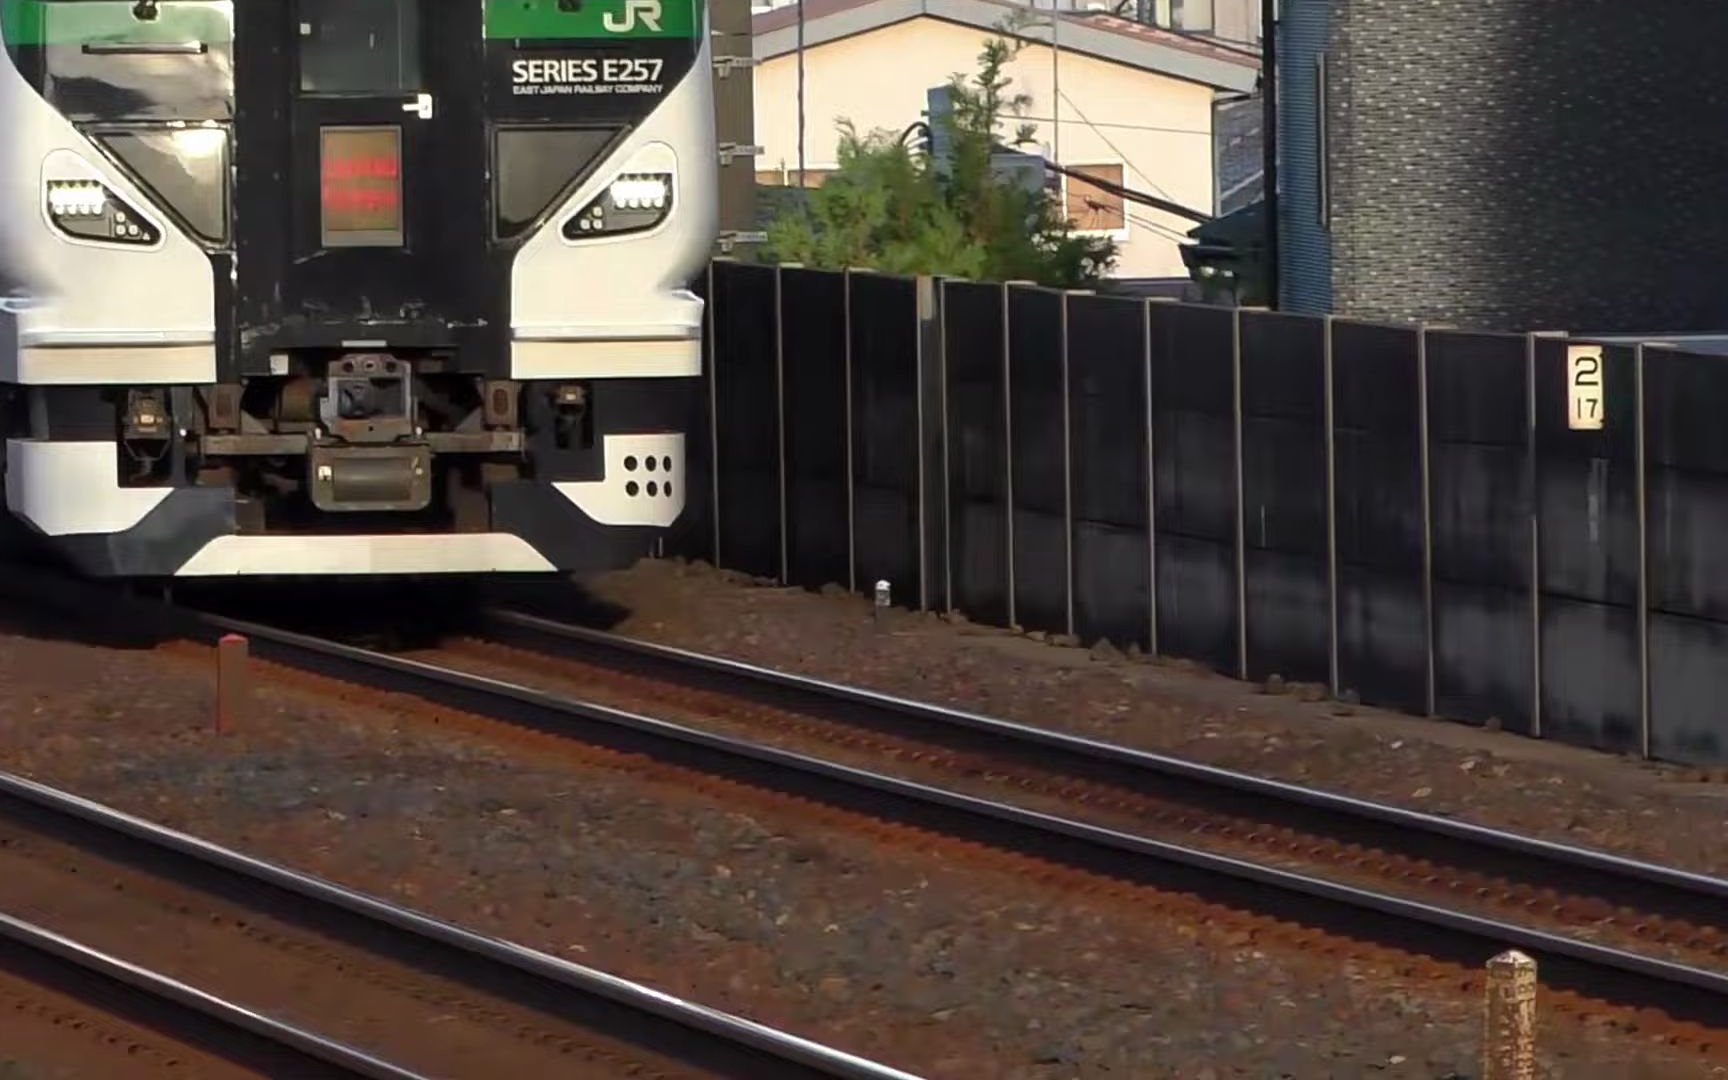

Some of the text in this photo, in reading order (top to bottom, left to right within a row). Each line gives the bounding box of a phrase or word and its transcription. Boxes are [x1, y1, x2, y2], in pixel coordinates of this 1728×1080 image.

[512, 58, 664, 84] SERIES E257
[1575, 356, 1599, 387] 2
[1577, 397, 1599, 419] 17
